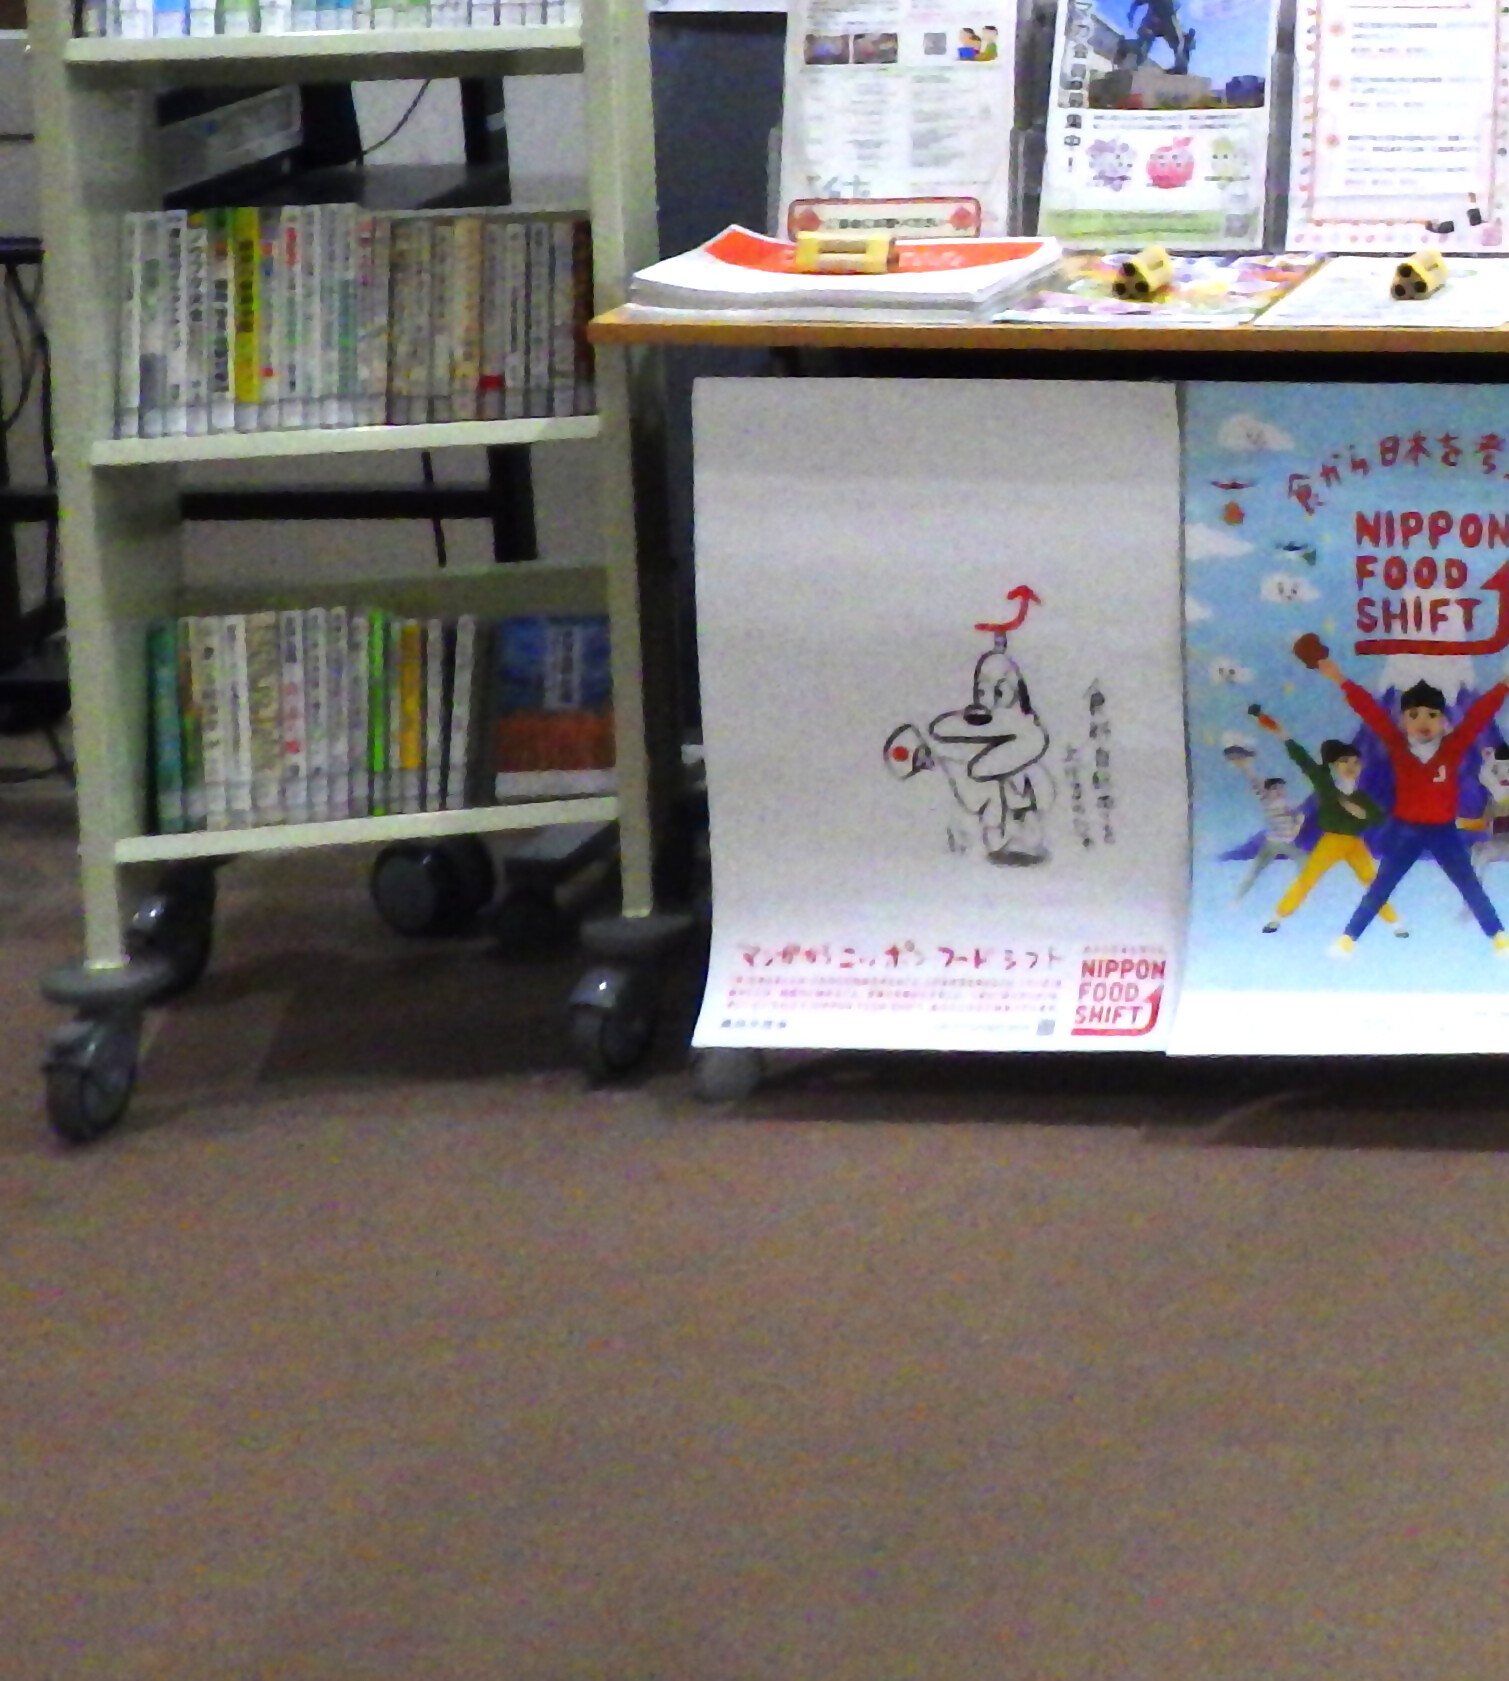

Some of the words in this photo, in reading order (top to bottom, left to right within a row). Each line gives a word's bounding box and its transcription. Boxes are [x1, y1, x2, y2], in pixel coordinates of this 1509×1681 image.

[1355, 554, 1469, 592] FOOD
[1355, 597, 1484, 635] SHIFT
[1081, 957, 1167, 980] NIPPON
[1078, 981, 1140, 1003] FOOD
[1074, 1004, 1143, 1026] SHIFT
